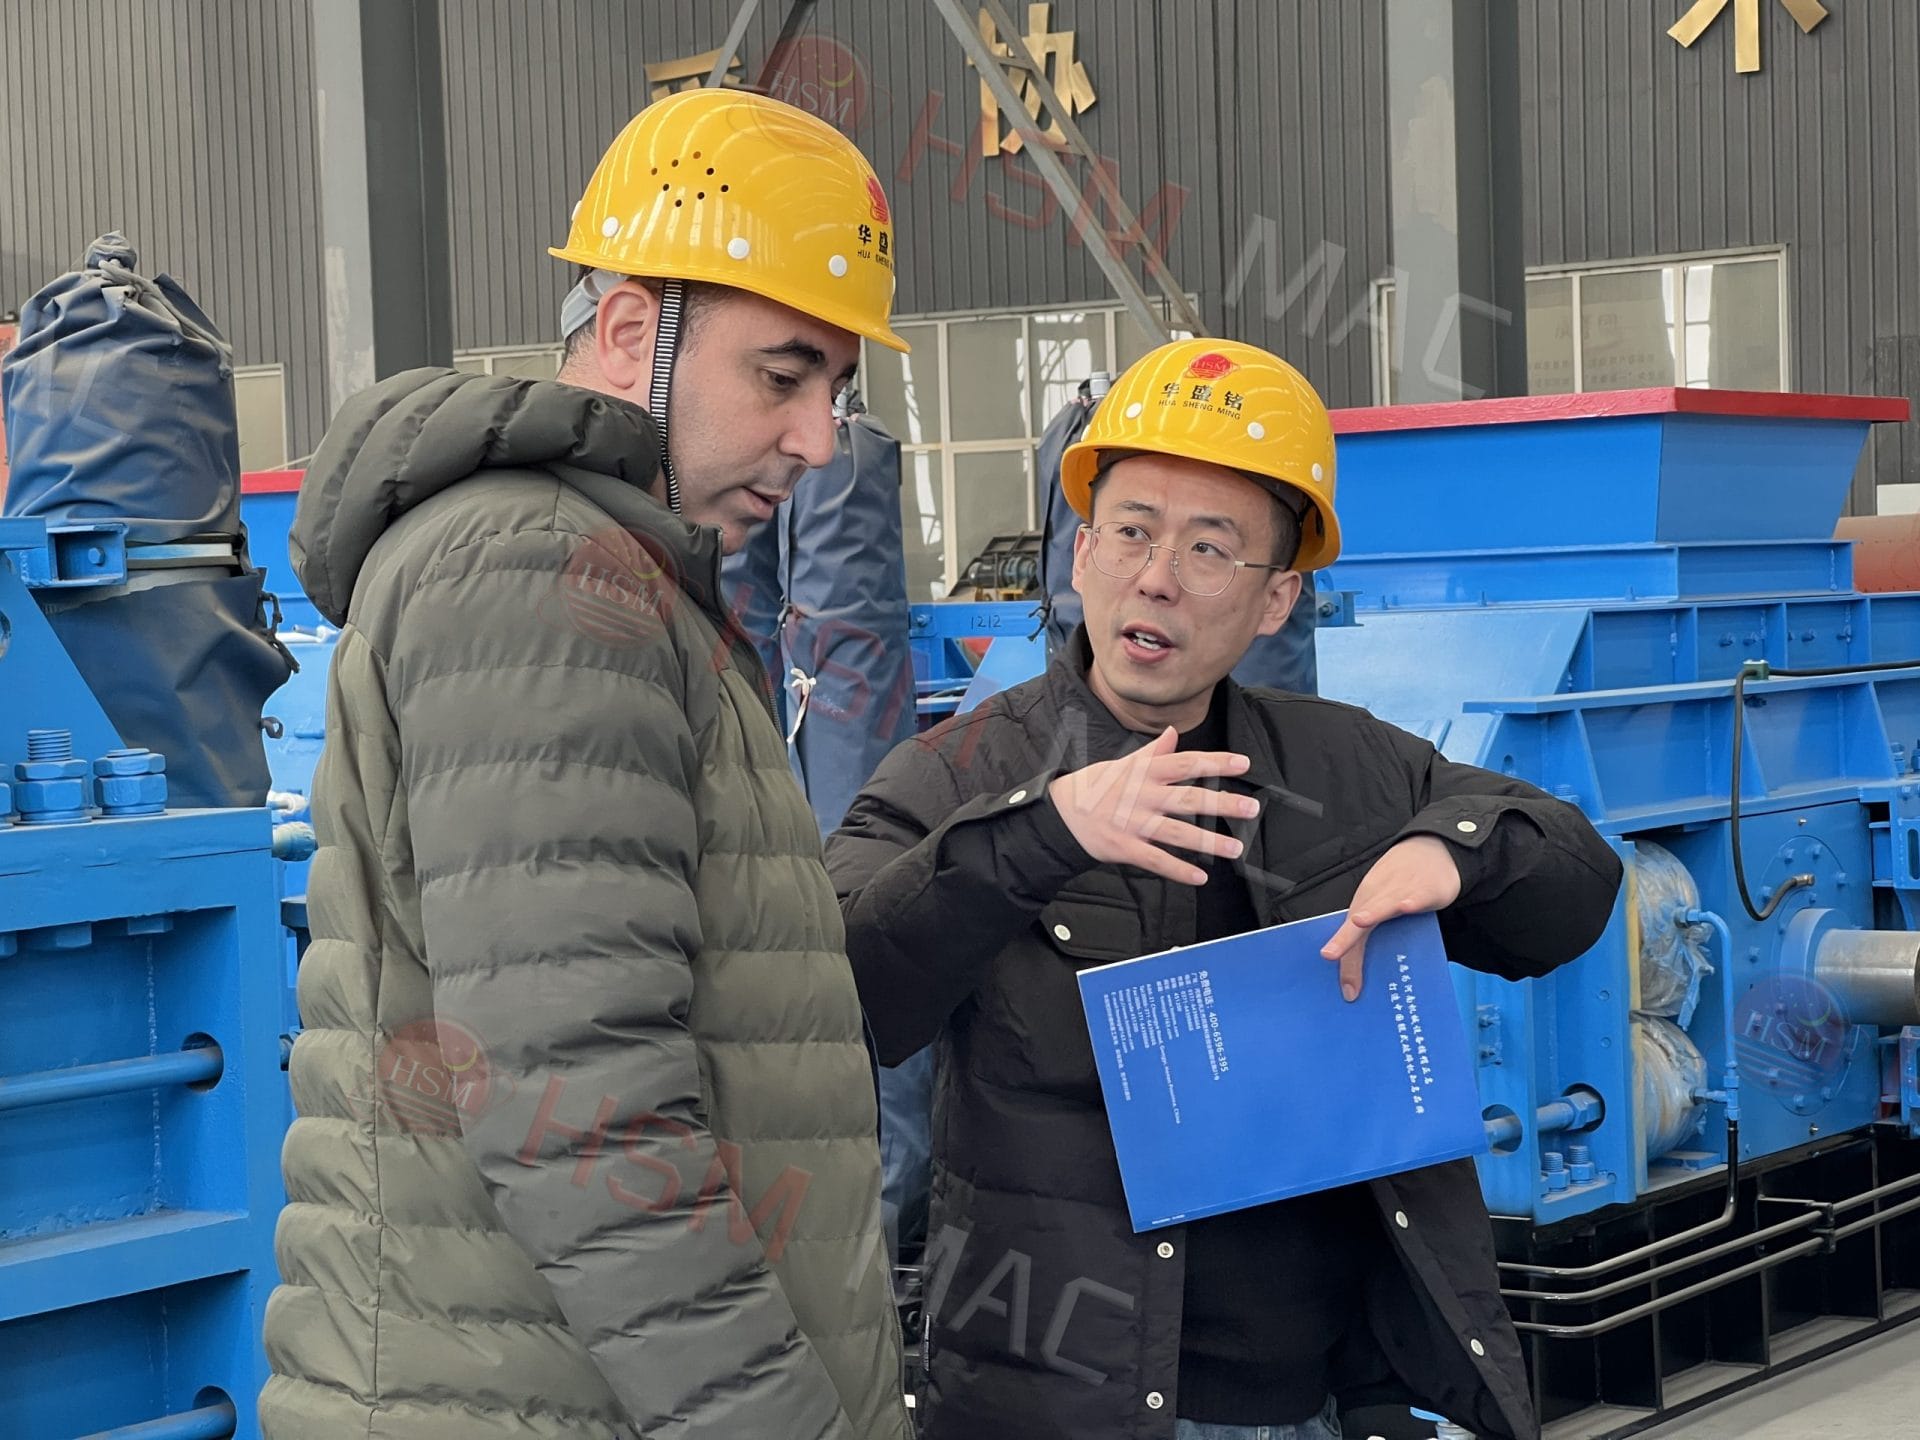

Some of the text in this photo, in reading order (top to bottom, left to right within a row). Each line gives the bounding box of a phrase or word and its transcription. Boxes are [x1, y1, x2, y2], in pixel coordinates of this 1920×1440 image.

[858, 223, 896, 256] 华盛
[1158, 399, 1241, 420] HUA SHENG MING
[1161, 382, 1244, 411] 华盛铭
